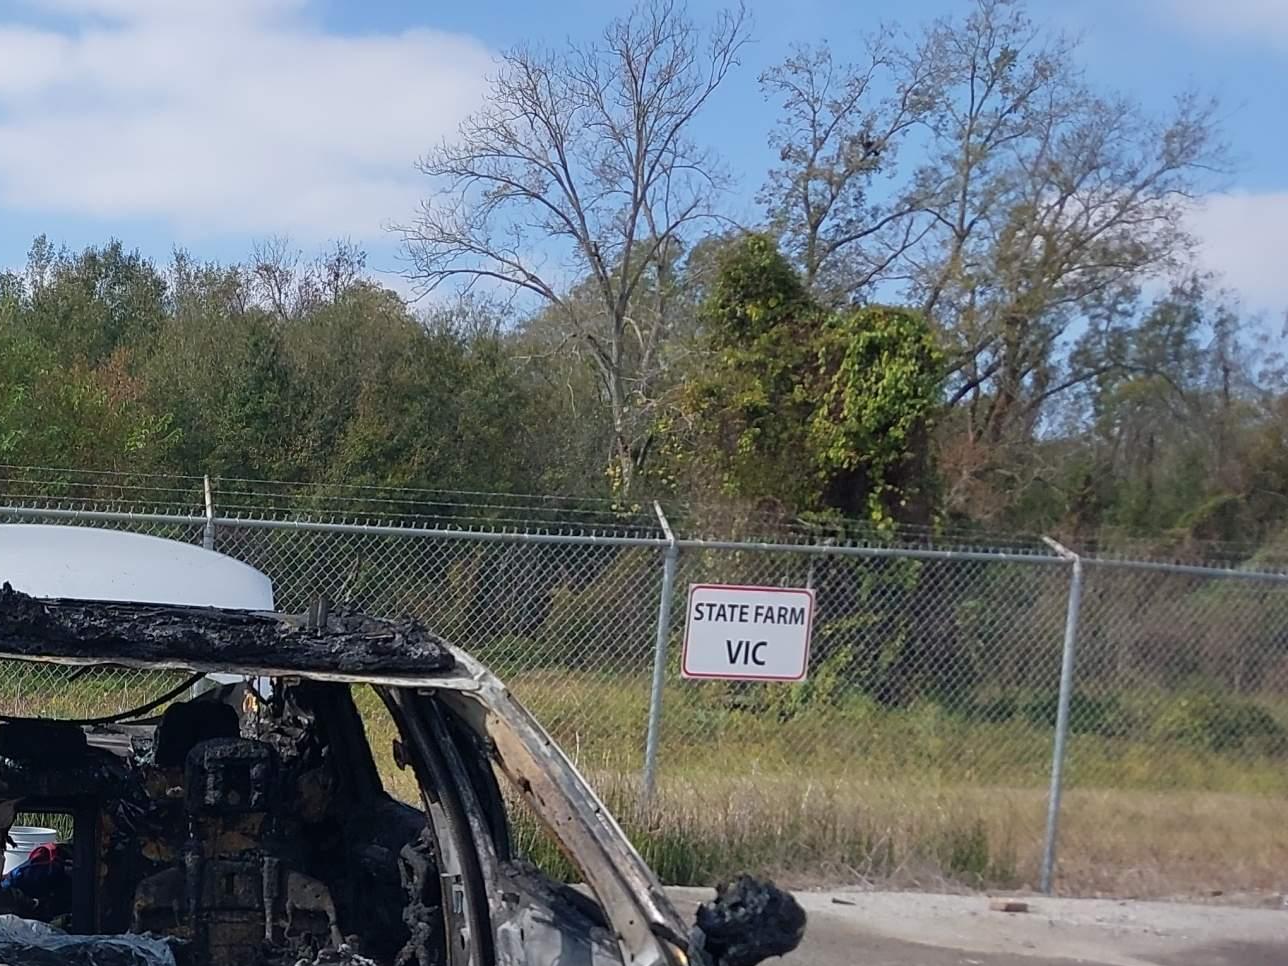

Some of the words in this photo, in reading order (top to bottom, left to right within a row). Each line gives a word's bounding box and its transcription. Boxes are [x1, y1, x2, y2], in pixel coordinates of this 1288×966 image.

[694, 603, 749, 622] STATE
[754, 605, 805, 625] FARM
[726, 640, 767, 665] VIC
